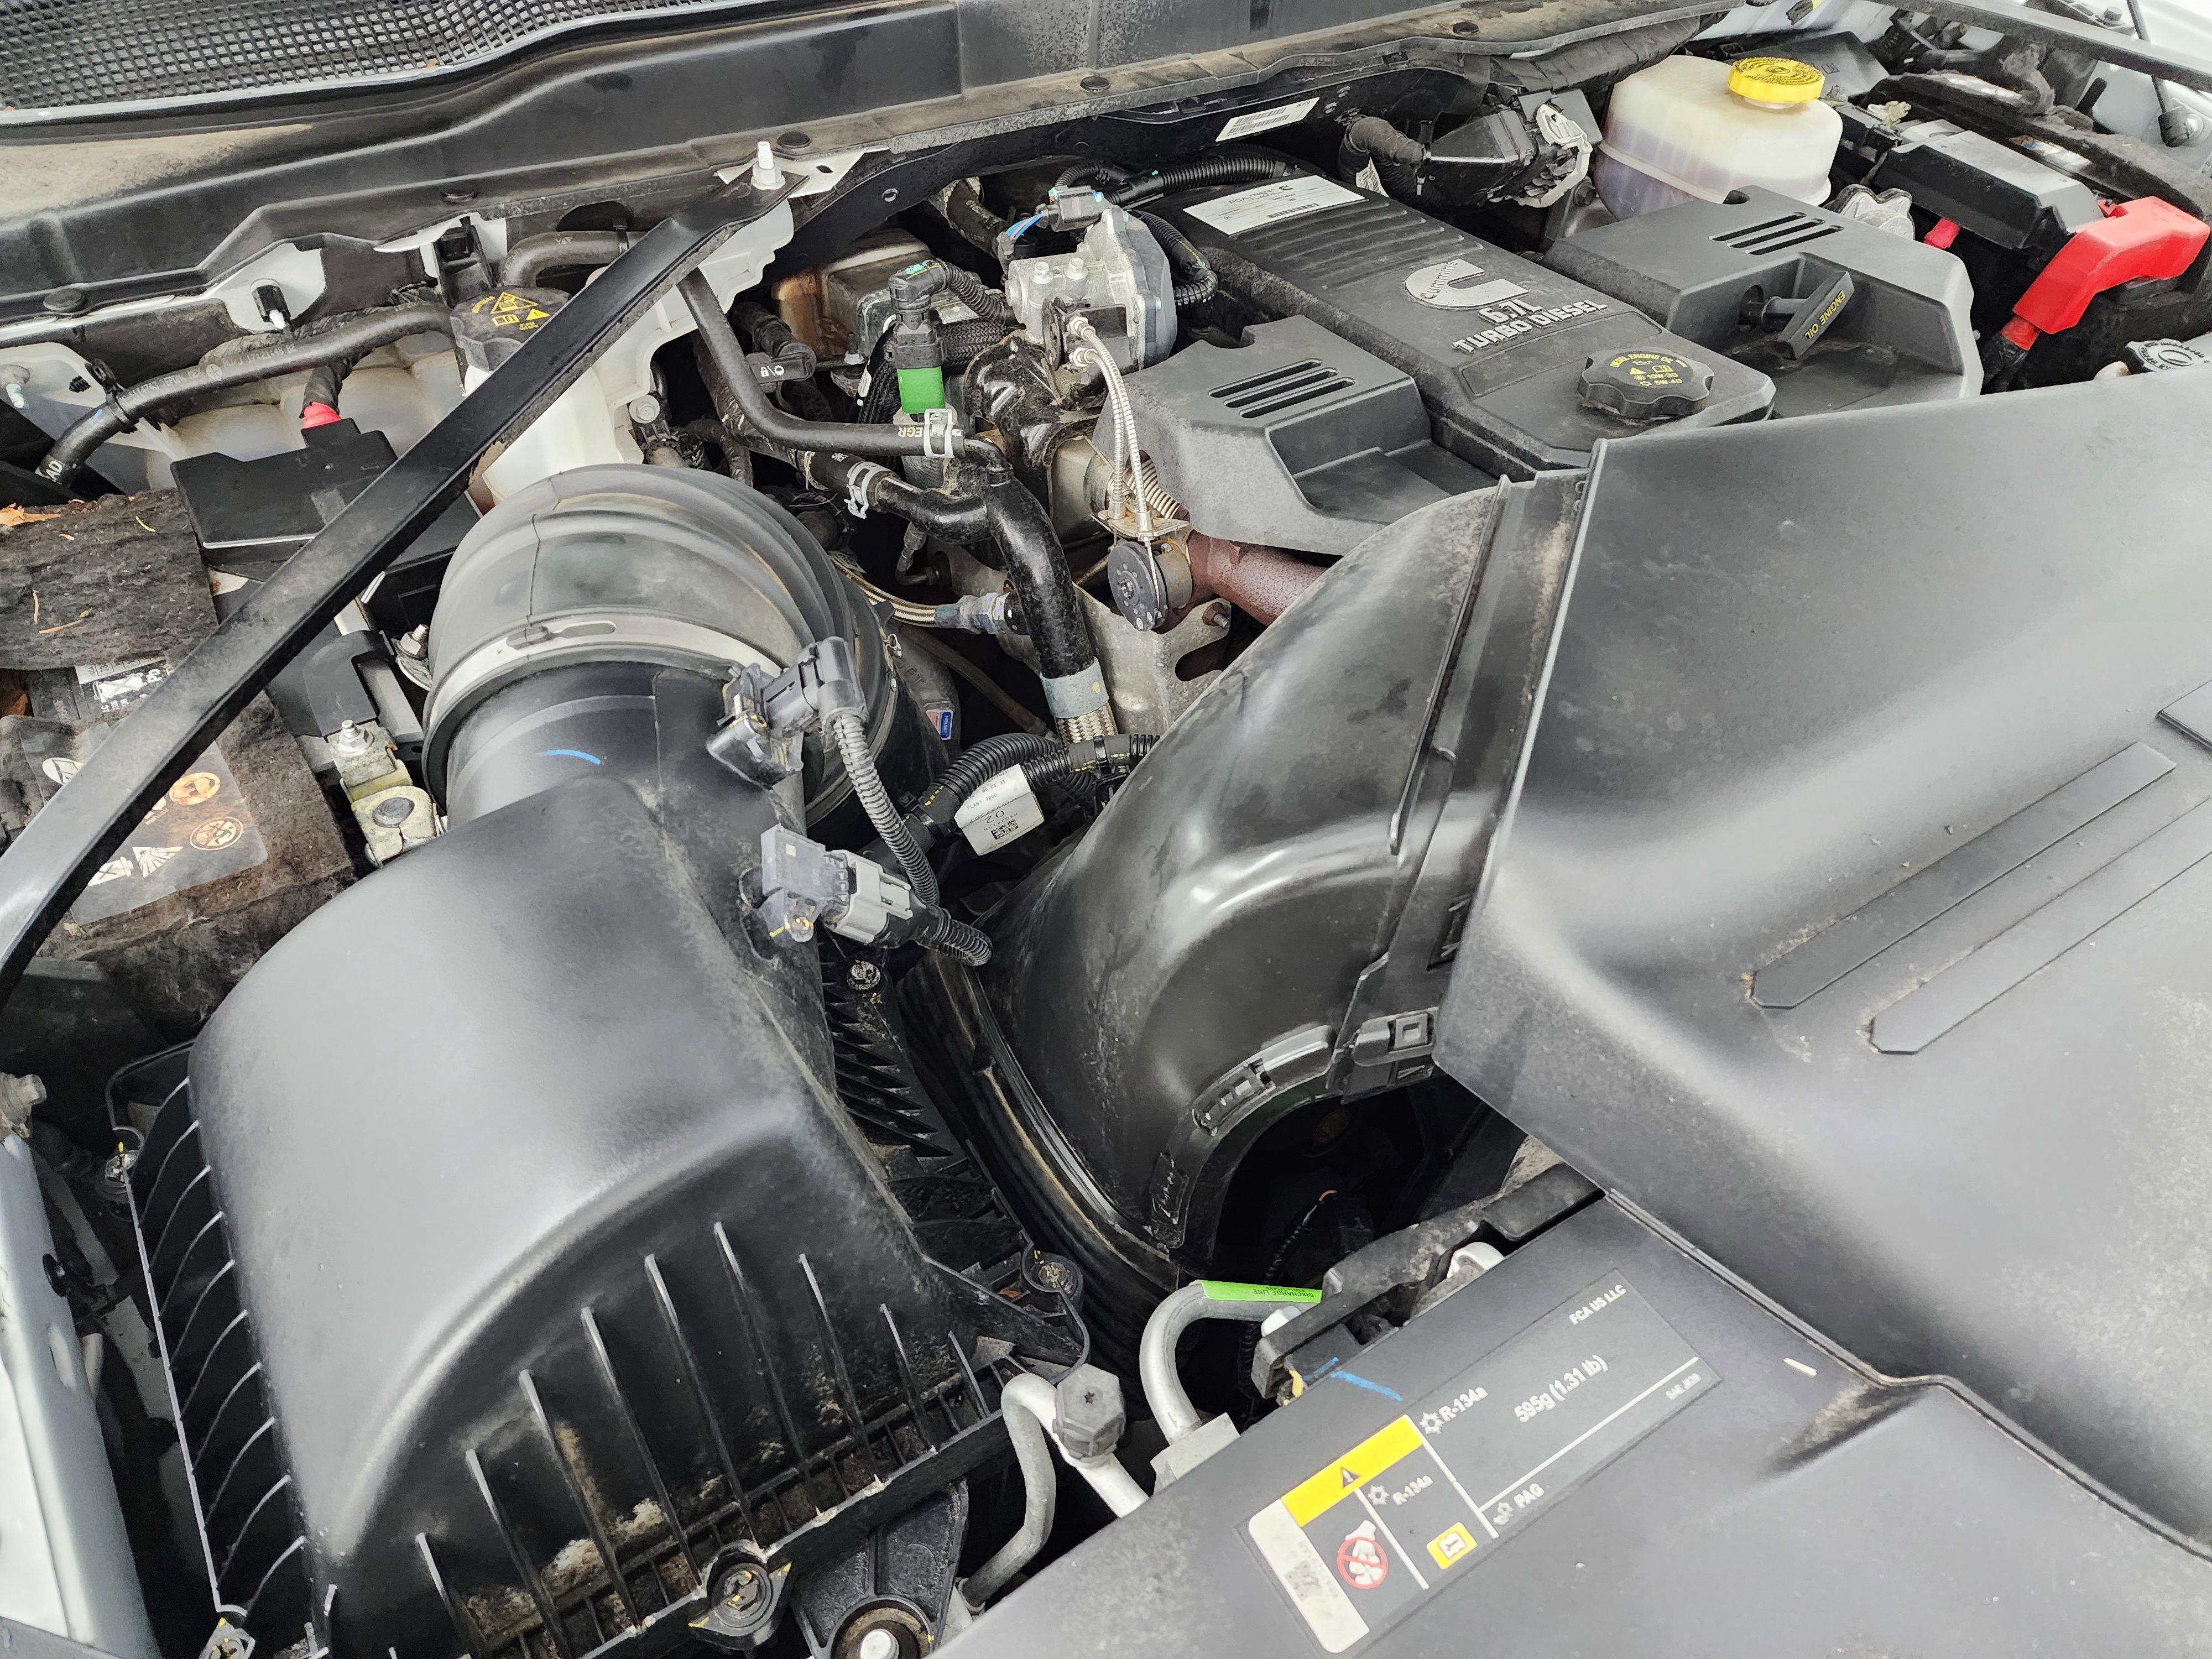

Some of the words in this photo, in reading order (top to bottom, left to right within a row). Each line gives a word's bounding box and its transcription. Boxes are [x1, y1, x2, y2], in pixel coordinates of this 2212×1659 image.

[1421, 260, 1458, 299] Cummins
[1478, 299, 1543, 324] 6.7L
[1819, 290, 1846, 325] ENGINE
[1452, 320, 1533, 353] TURBO
[1527, 300, 1608, 328] DIESEL
[1804, 324, 1819, 339] OIL
[1610, 356, 1630, 368] DIESEL
[1661, 356, 1674, 364] OIL
[898, 426, 924, 438] EGR
[831, 452, 849, 462] ENG
[144, 807, 169, 825] RETURN
[1569, 1306, 1594, 1326] FCA
[1589, 1297, 1608, 1312] US
[1603, 1284, 1627, 1303] LLC
[1514, 1392, 1556, 1423] 595g
[1548, 1367, 1587, 1402] (1.31
[1580, 1354, 1609, 1378] lb)
[1438, 1386, 1489, 1423] R-134a
[1392, 1475, 1434, 1506] R-134a
[1514, 1483, 1545, 1509] PAG
